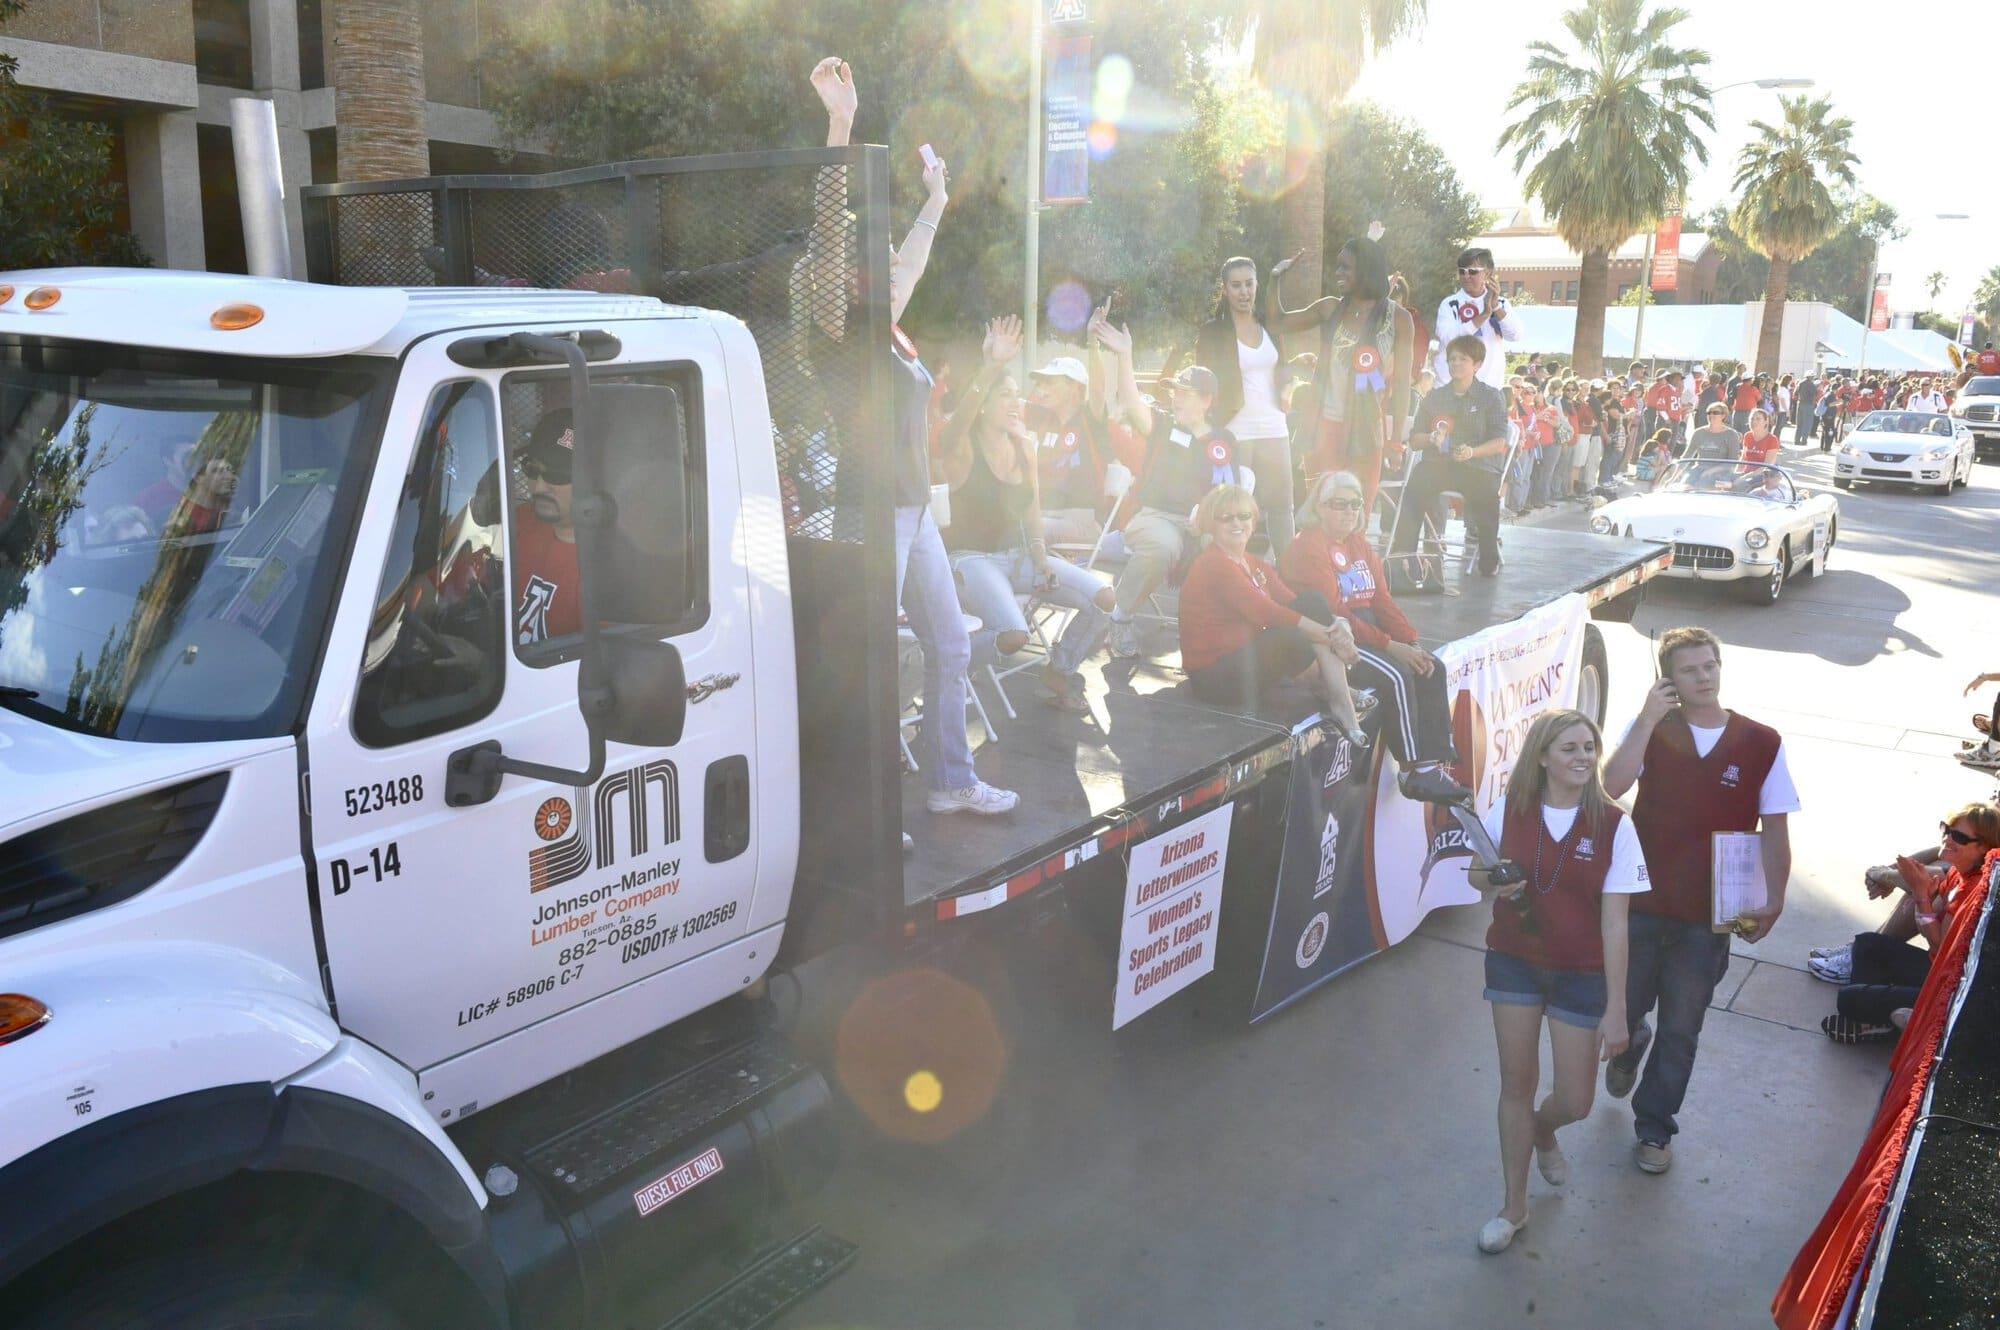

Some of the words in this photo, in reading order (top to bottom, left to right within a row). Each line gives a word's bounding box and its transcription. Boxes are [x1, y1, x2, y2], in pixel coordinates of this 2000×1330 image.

[1490, 662, 1564, 724] WOMEN'S
[345, 774, 423, 817] 523488
[330, 842, 401, 896] D-14
[1160, 831, 1205, 868] Arizona
[532, 858, 680, 926] Johnson-Manley
[1135, 850, 1218, 906] Letterwinners
[531, 909, 597, 947] Lumber
[604, 878, 680, 917] Company
[558, 913, 657, 966] 882-0885
[583, 922, 616, 938] Tucson,
[621, 924, 678, 964] USDOT#
[681, 900, 738, 939] 1302569
[1148, 890, 1202, 935] Women's
[1129, 935, 1170, 971] Sports
[1172, 910, 1213, 947] Legacy
[457, 998, 501, 1027] LIC#
[506, 975, 555, 1008] 58906
[560, 964, 585, 985] C-7
[1134, 942, 1203, 996] Celebration
[74, 1100, 92, 1116] 105
[638, 1180, 674, 1211] DIESEL
[671, 1167, 697, 1192] FUEL
[694, 1151, 718, 1177] ONLY
